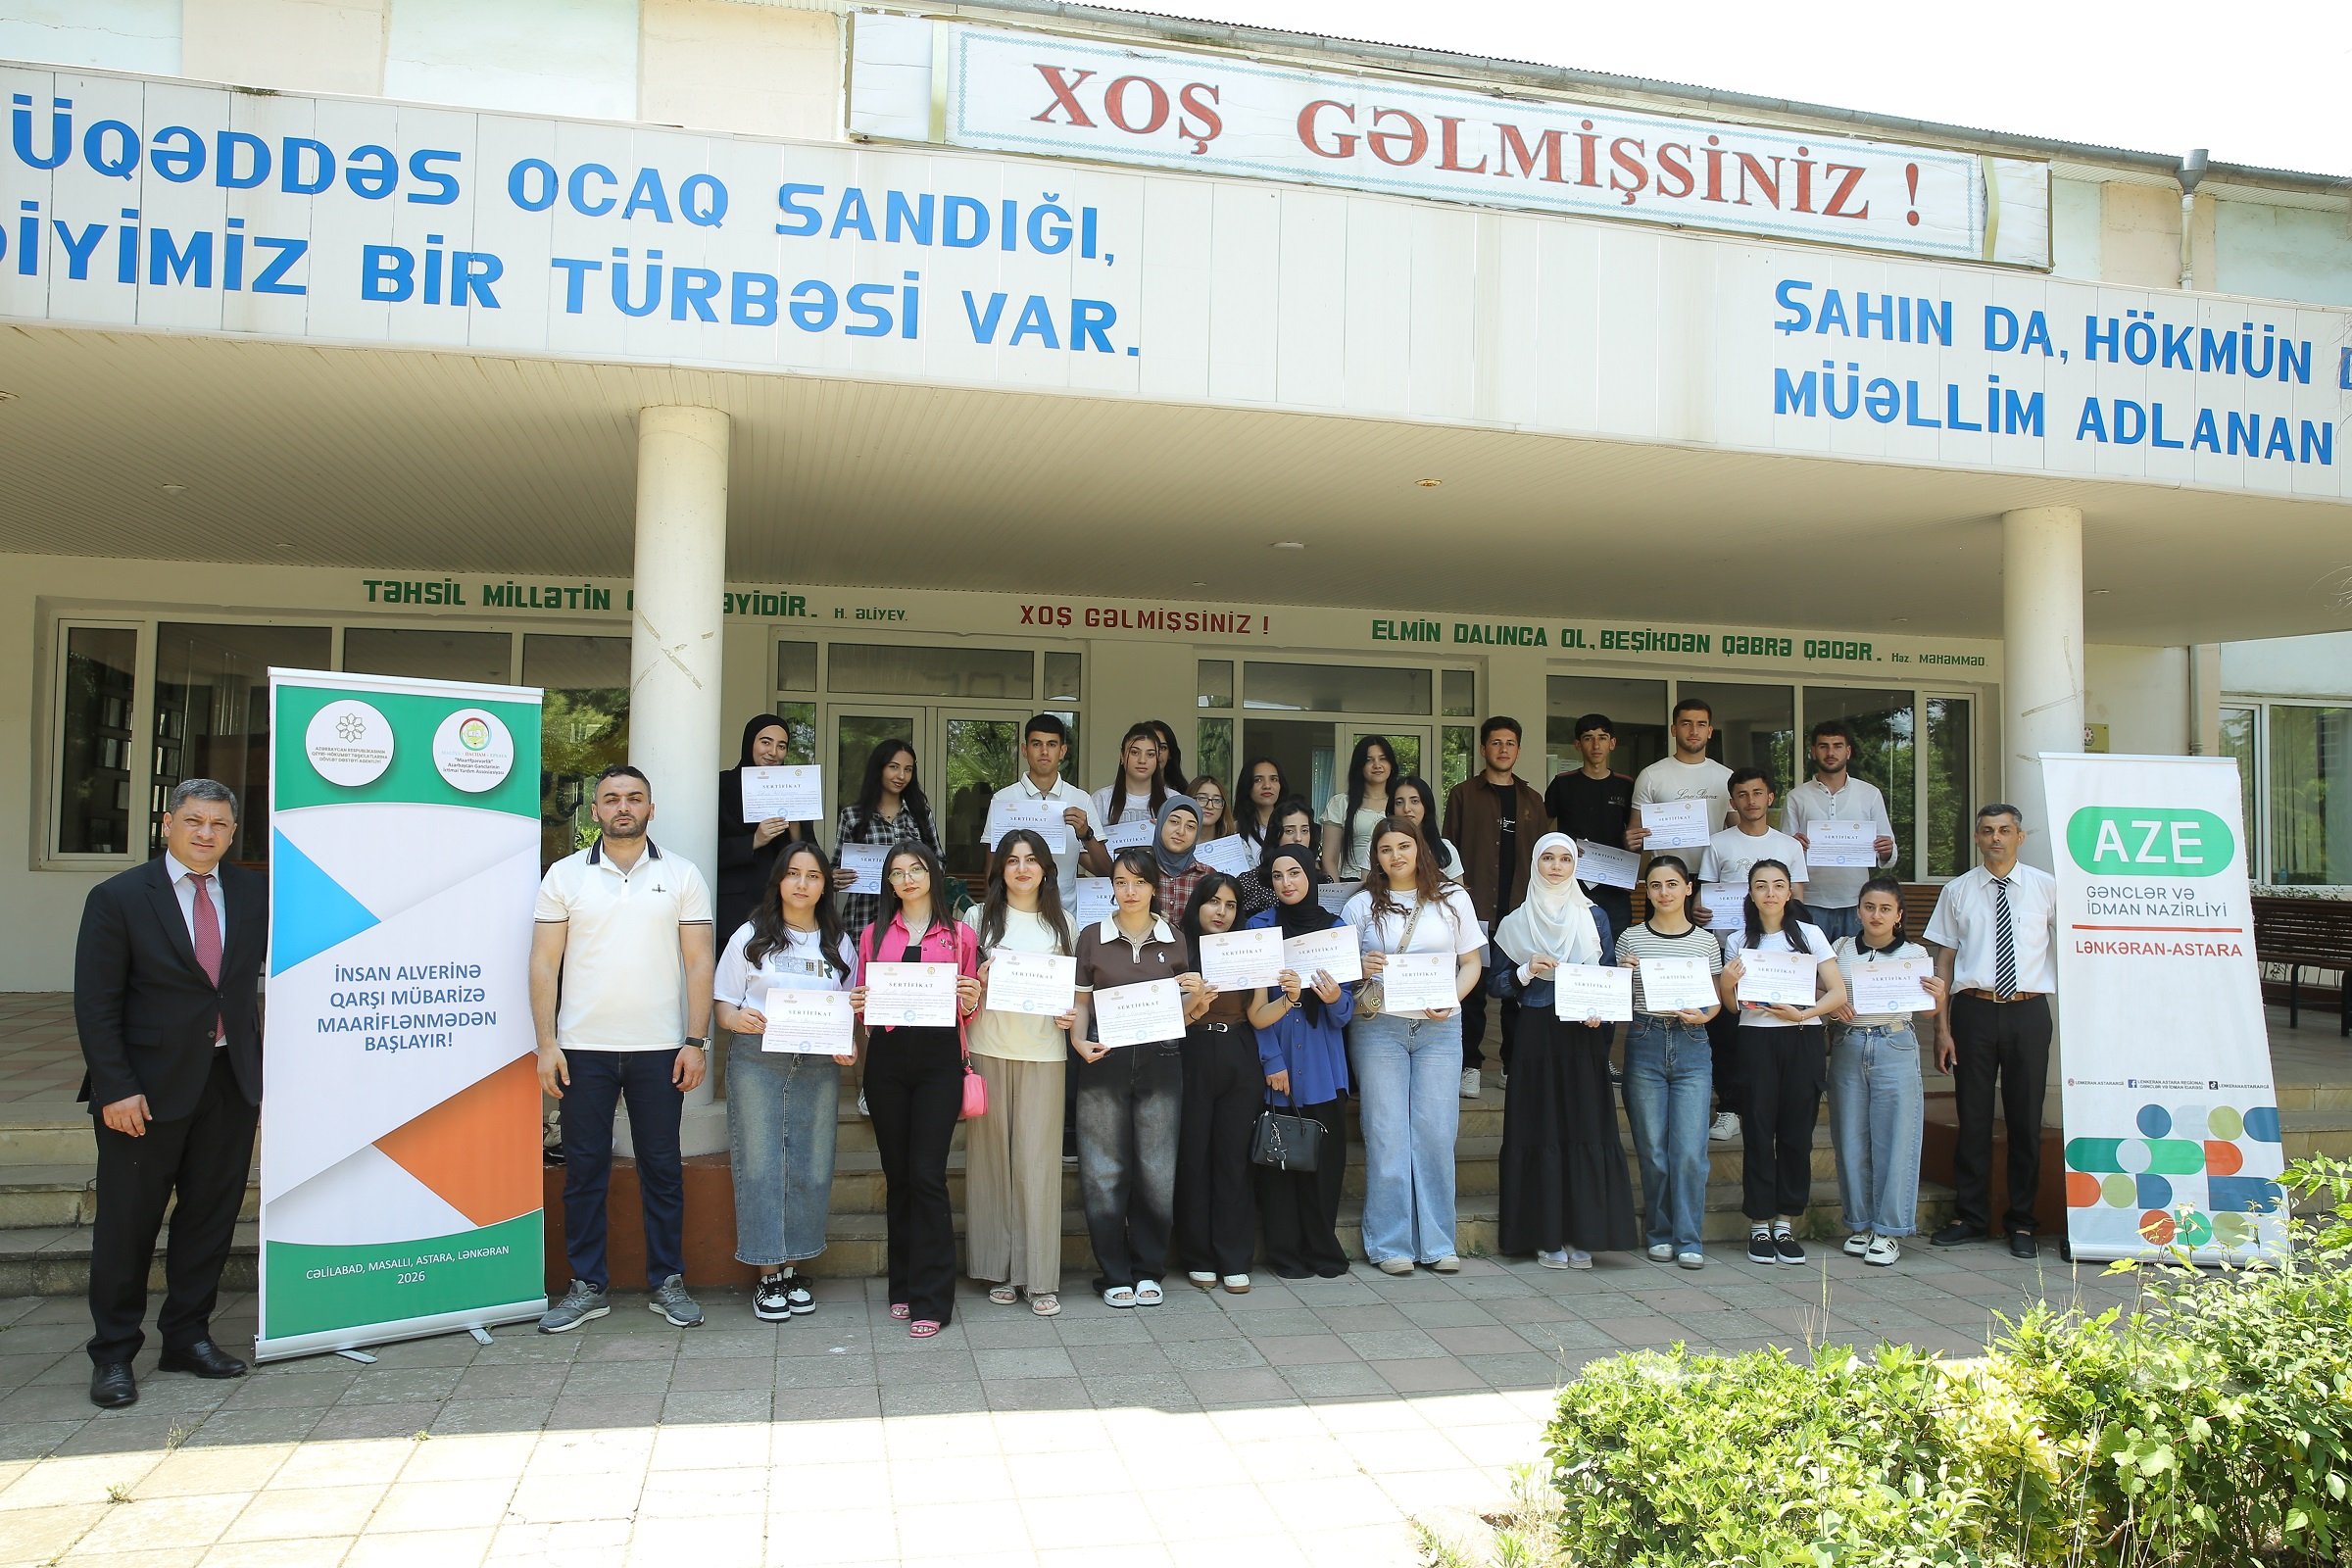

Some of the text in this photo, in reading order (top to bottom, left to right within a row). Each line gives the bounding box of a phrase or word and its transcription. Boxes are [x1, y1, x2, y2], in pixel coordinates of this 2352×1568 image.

[1031, 63, 1222, 154] XOŞ
[1297, 99, 1871, 220] GƏLMİŞSİNİZ
[13, 93, 1115, 267] ÜQƏDDƏS OCAQ SANDIĞI,
[361, 234, 504, 309] BİR
[551, 247, 919, 339] TÜRBƏSİ
[961, 290, 1140, 357] VAR.
[1775, 279, 1953, 346] ŞAHIN
[1985, 306, 2069, 366] DA,
[2085, 310, 2312, 385] HÖKMÜN
[1775, 361, 2333, 466] MÜƏLLİM ADLANAN
[363, 578, 466, 606] TƏHSİL
[483, 581, 610, 610] MİLLƏTİN
[1020, 605, 1072, 628] XOŞ
[1085, 608, 1251, 634] GƏLMİŞSİNİZ
[1372, 618, 1442, 643] ELMİN
[1454, 623, 1548, 647] DALINCA
[1600, 628, 1711, 655] BEŞİKDƏN
[1722, 635, 1792, 659] QƏBRƏ
[1804, 639, 1882, 662] QƏDƏR.
[2092, 819, 2204, 864] AZE
[2086, 885, 2195, 901] GƏNCLƏR VƏ
[2087, 900, 2228, 917] İDMAN NAZİRLİYİ
[2076, 940, 2243, 957] LƏNKƏRAN-ASTARA
[335, 961, 482, 983] İNSAN ALVERİNƏ
[329, 985, 486, 1010] QARŞI MÜBARİZƏ
[318, 1011, 497, 1034] MAARİFLƏNMƏDƏN
[365, 1032, 454, 1054] BAŞLAYIR!
[306, 1246, 510, 1280] CƏLİLABAD, MASALLI, ASTARA, LƏNKƏRAN
[397, 1271, 425, 1284] 2026
